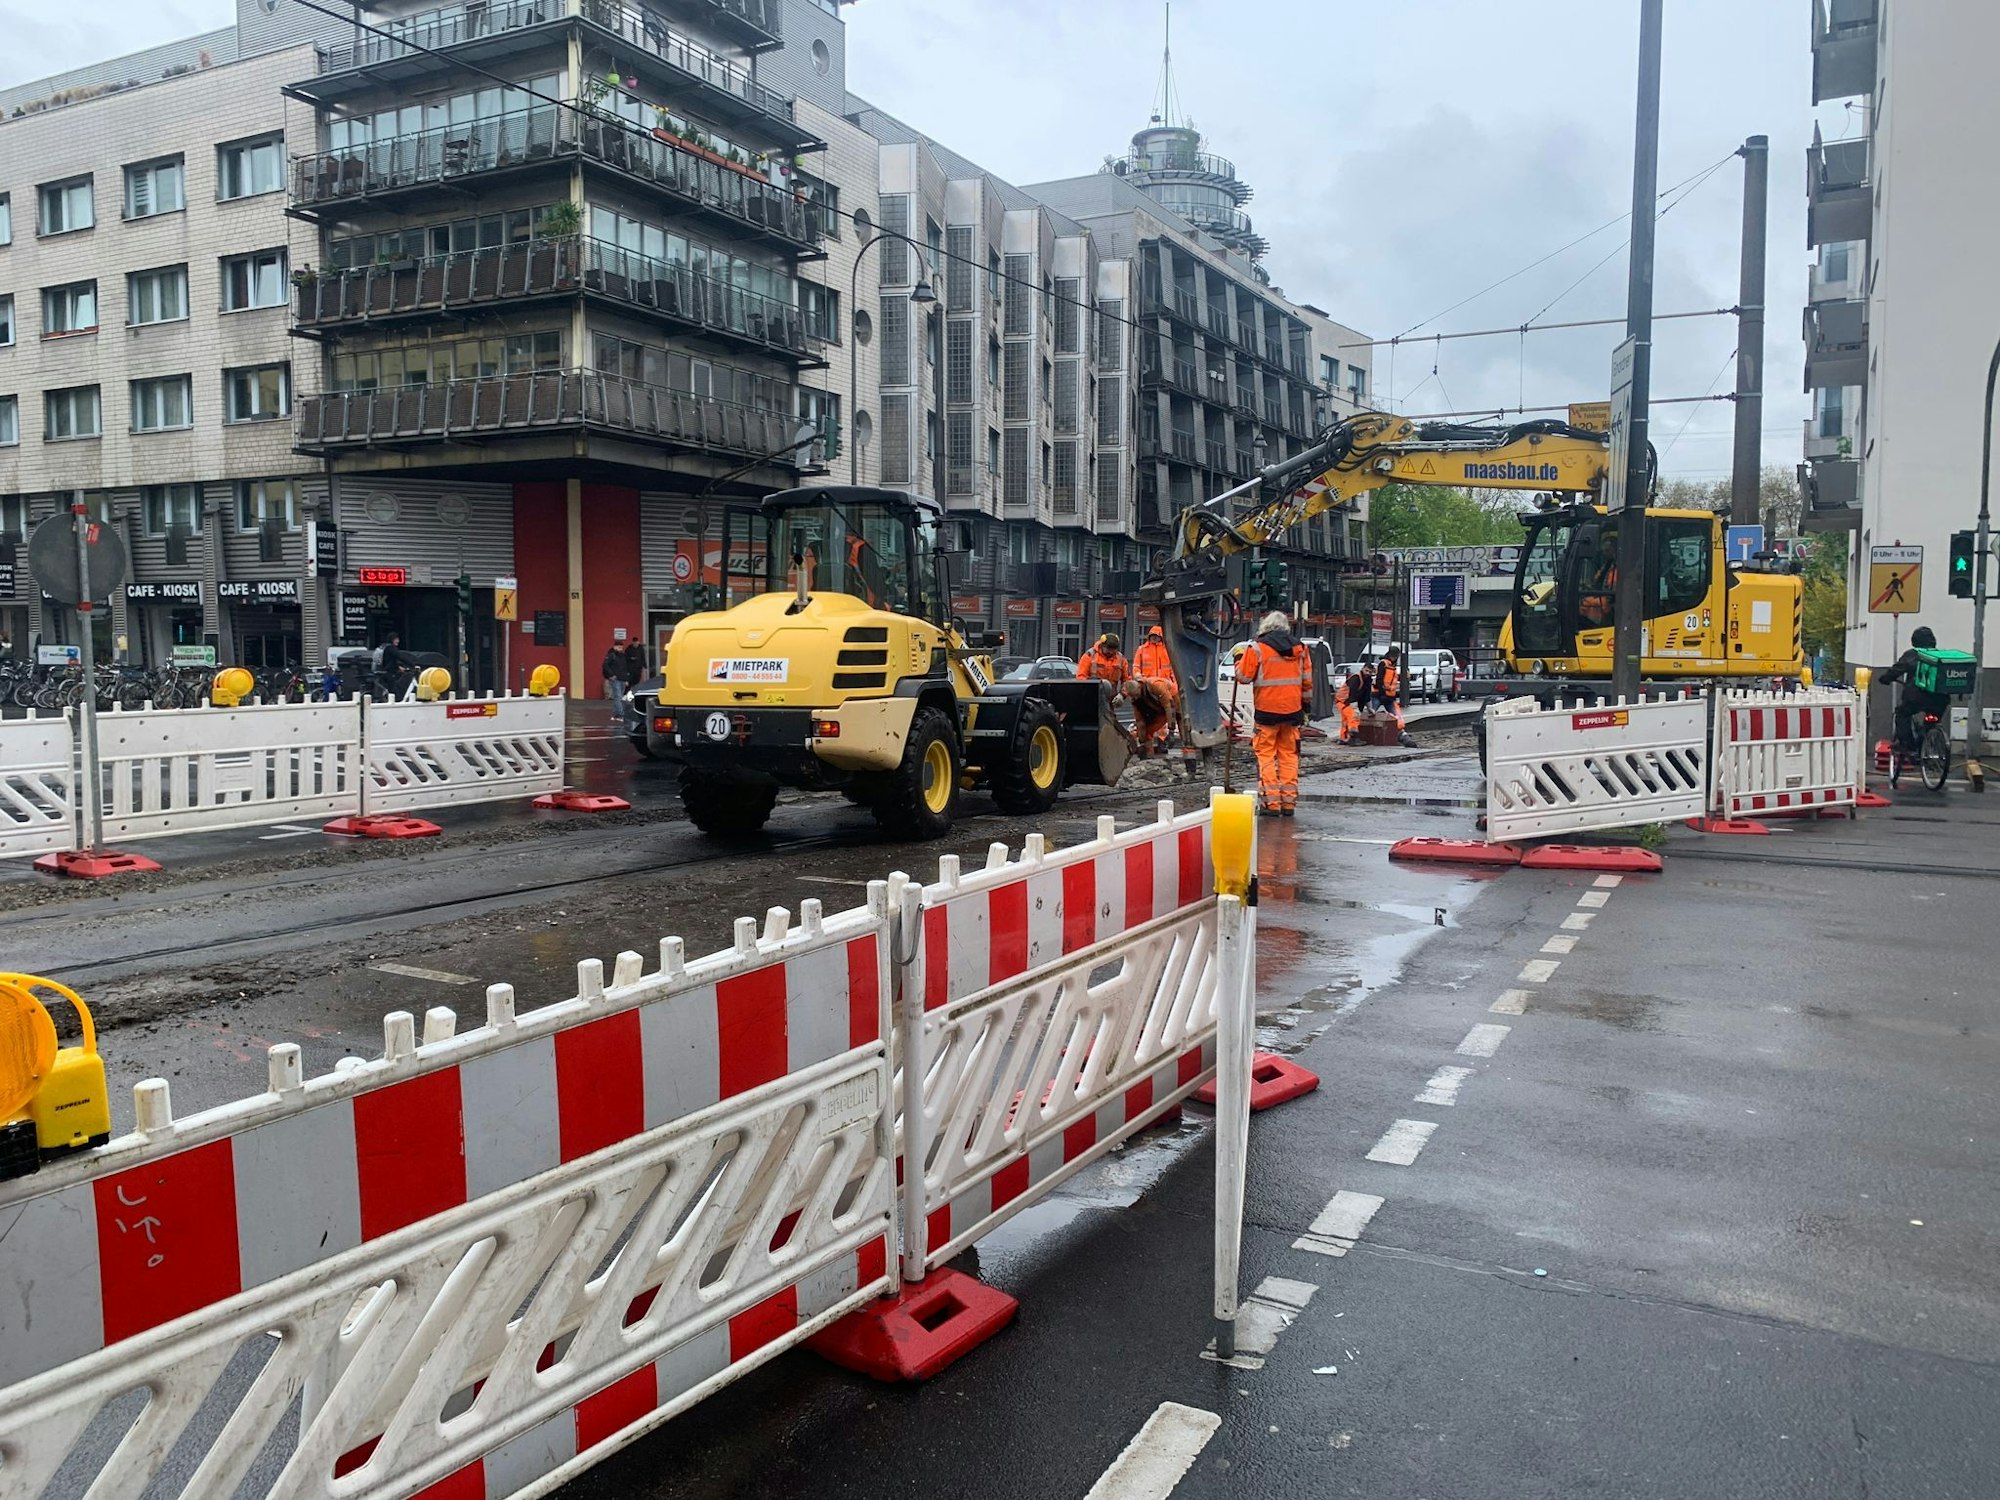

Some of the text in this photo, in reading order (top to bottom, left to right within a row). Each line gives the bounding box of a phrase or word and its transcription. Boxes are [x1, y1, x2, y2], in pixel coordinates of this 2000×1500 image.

[1464, 462, 1558, 481] maasbau.de
[317, 531, 336, 539] KIOSK
[318, 542, 335, 550] CAFE
[378, 572, 399, 581] to go
[127, 585, 155, 597] CAFE
[163, 584, 198, 597] KIOSK
[219, 583, 249, 596] CAFE
[258, 582, 296, 595] KIOSK
[1687, 616, 1697, 628] 20
[732, 661, 783, 671] MIETPARK
[969, 661, 988, 688] MIETP
[1946, 669, 1968, 678] Uber
[452, 707, 480, 715] ZEPPELIN
[711, 718, 726, 735] 20
[1578, 716, 1609, 726] ZEPPELIN
[55, 1098, 90, 1112] ZEPPELIN
